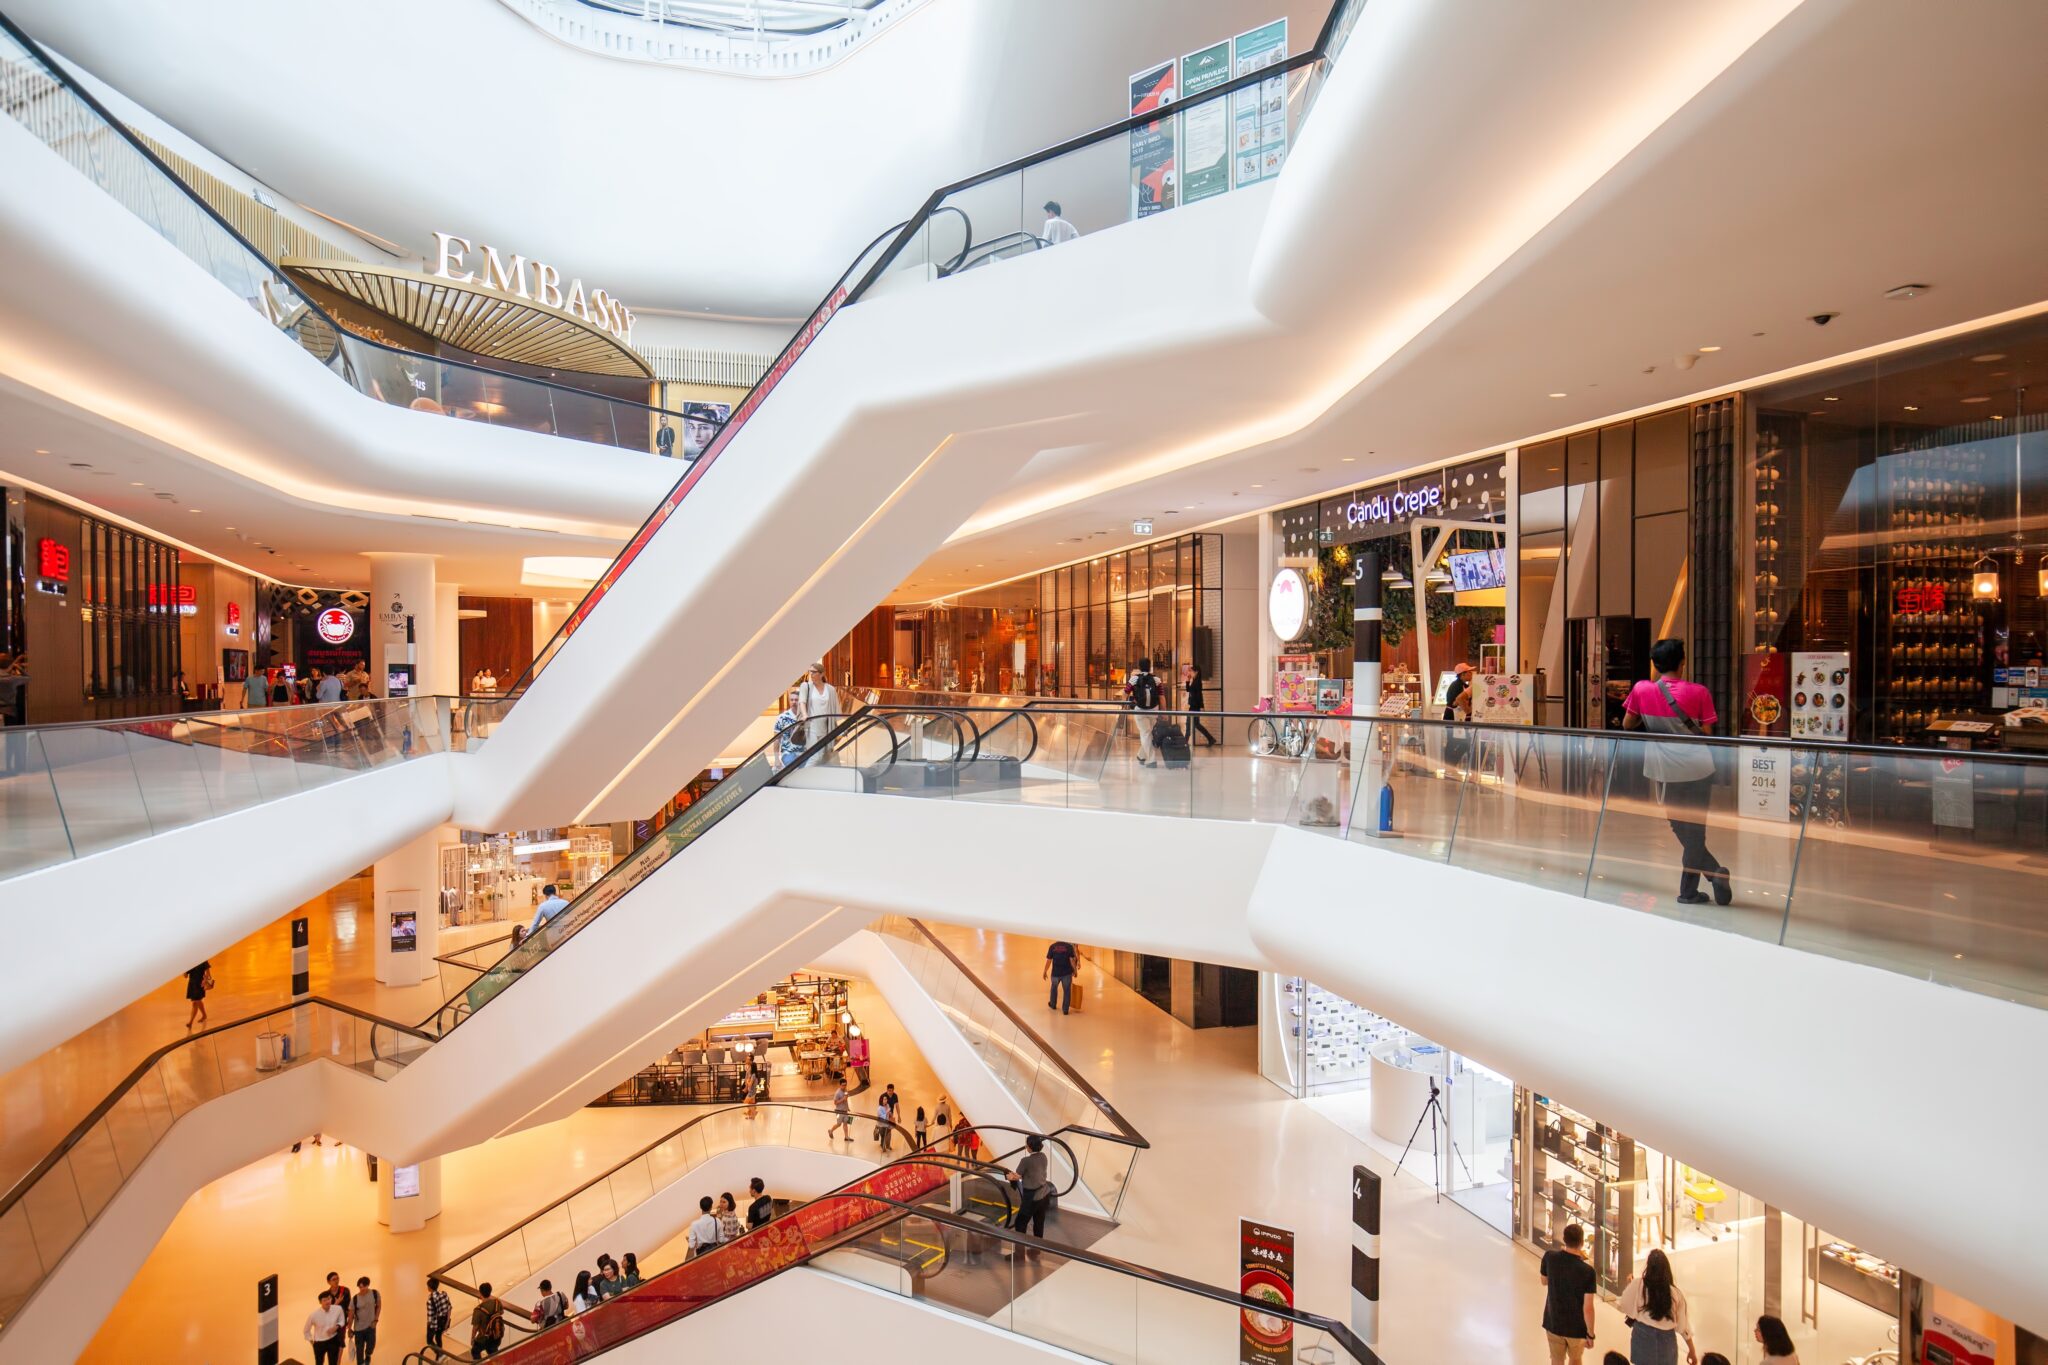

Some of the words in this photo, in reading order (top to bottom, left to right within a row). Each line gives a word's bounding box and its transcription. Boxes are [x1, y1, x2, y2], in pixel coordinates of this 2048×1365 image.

[1185, 76, 1200, 86] OPEN
[1202, 66, 1229, 80] PRIVILEGE
[1132, 139, 1148, 149] EARLY
[431, 231, 637, 349] EMBASSY
[1347, 494, 1390, 524] Candy
[1392, 487, 1440, 515] Crepe
[1356, 558, 1363, 580] 5
[1752, 758, 1776, 770] BEST
[1752, 776, 1776, 788] 2014
[640, 856, 651, 866] PLUS
[298, 922, 304, 934] 4
[1354, 1178, 1362, 1200] 4
[1260, 1230, 1282, 1240] IPPUDO
[264, 1283, 270, 1296] 3
